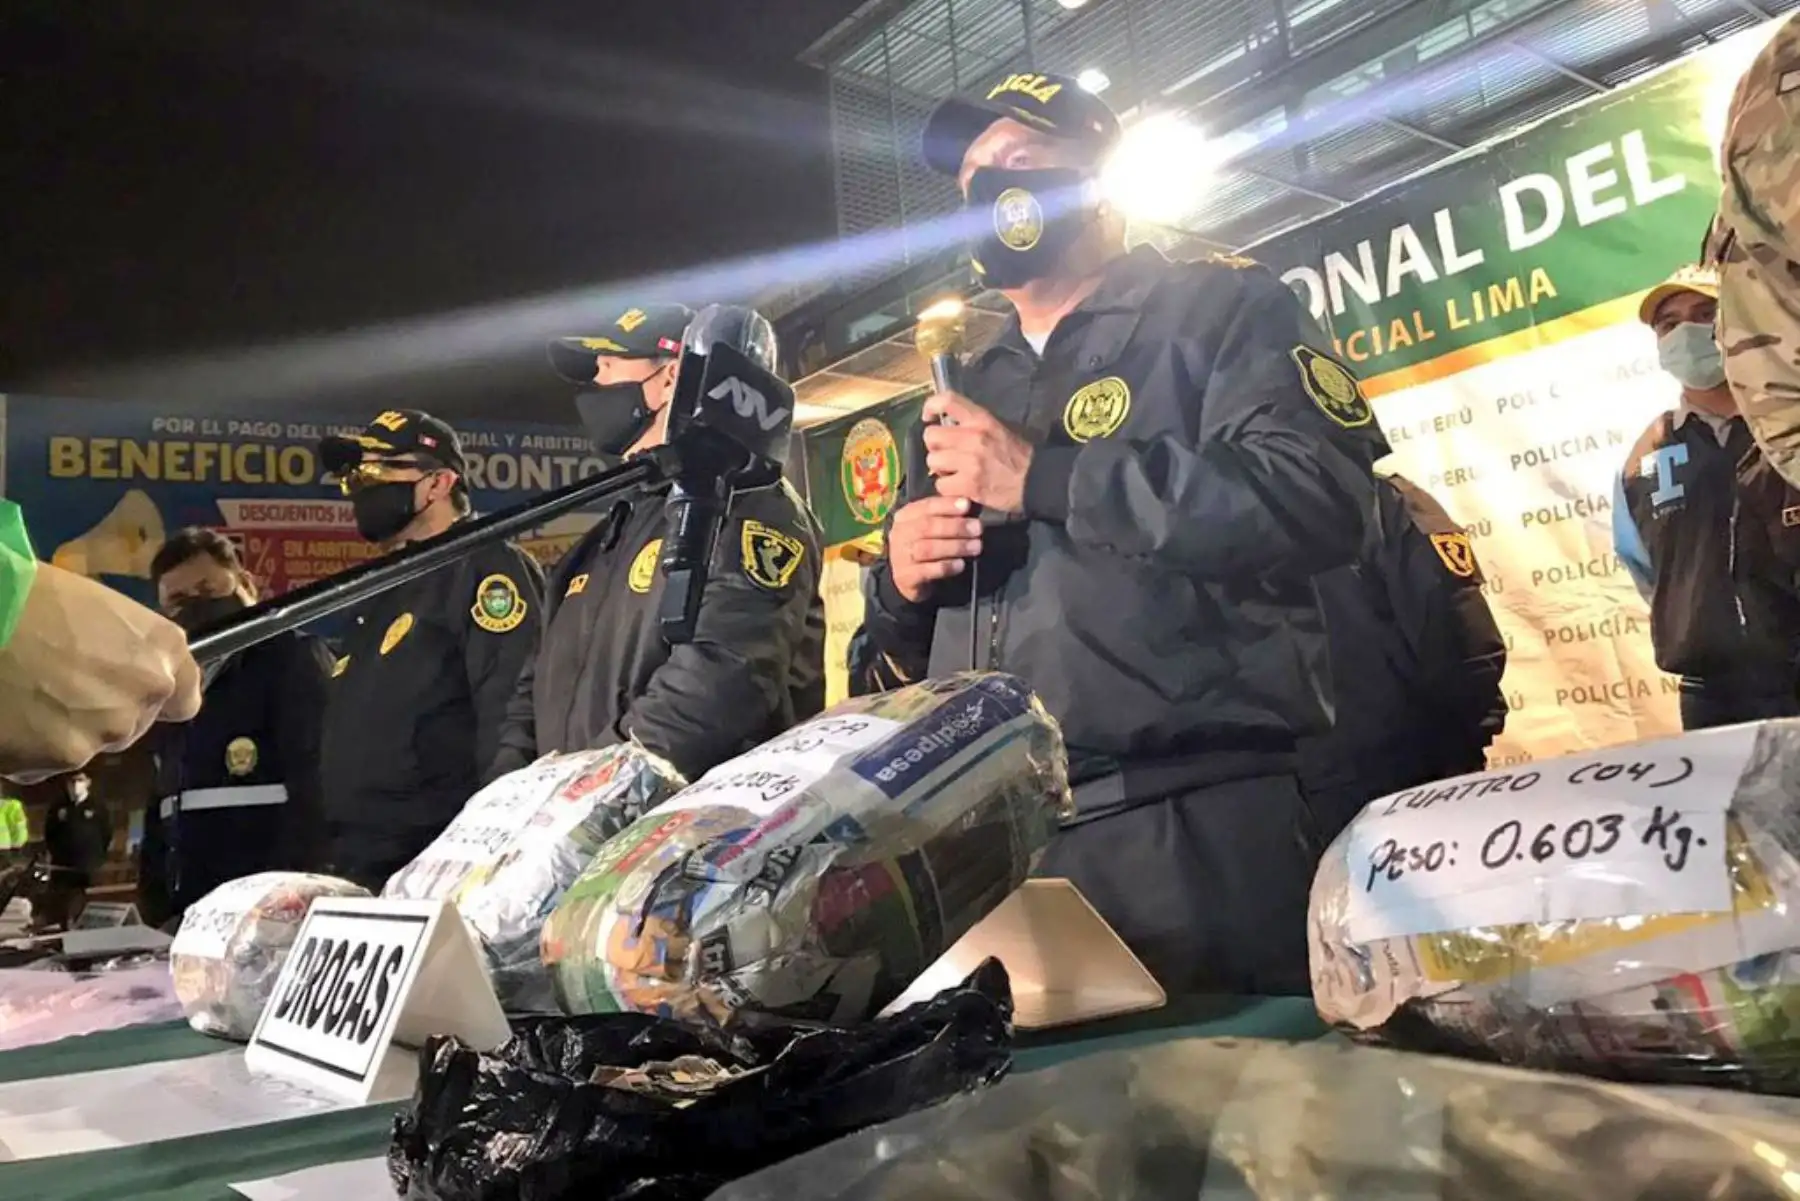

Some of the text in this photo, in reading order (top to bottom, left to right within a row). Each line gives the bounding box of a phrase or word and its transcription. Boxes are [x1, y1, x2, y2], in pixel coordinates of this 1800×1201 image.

[1498, 129, 1686, 252] DEL
[1446, 267, 1558, 331] LIMA
[152, 417, 194, 433] POR
[202, 420, 222, 435] EL
[228, 421, 281, 437] PAGO
[287, 424, 321, 439] DEL
[505, 433, 516, 447] Y
[49, 436, 315, 485] BENEFICIO
[239, 504, 336, 522] DESCUENTOS
[1481, 812, 1626, 869] 0.603
[275, 936, 404, 1045] DROGAS
